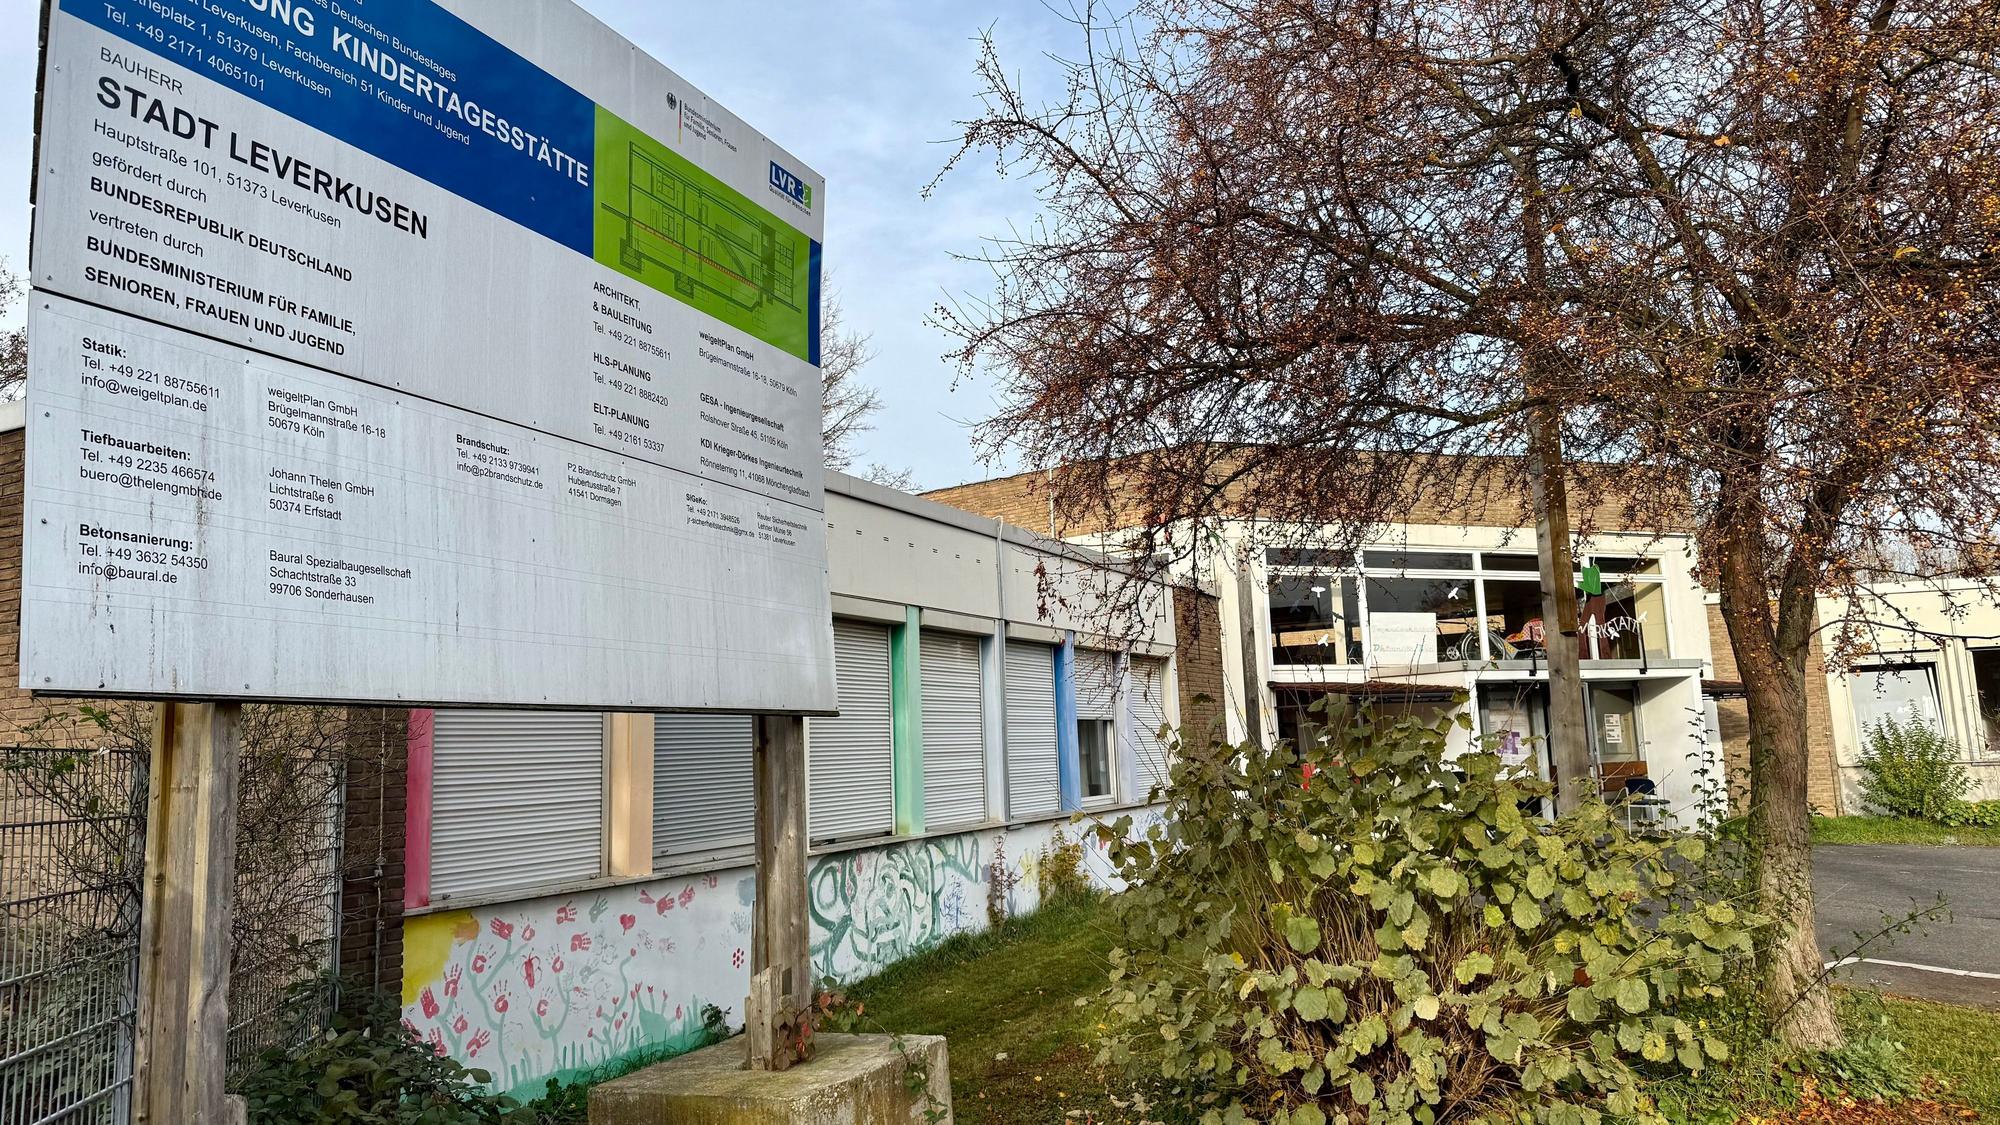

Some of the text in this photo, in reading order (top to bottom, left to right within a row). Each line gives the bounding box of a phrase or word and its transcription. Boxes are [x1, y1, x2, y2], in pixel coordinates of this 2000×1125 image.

[104, 3, 264, 92] Tel. +49 2171 4065101
[132, 0, 332, 98] theplatz 1, 51379 Leverkusen
[310, 0, 456, 82] es Deutschen Bundestages
[100, 46, 182, 95] BAUHERR
[203, 0, 470, 145] Leverkusen, Fachbereich 51 Kinder und Jugend
[332, 26, 588, 187] KINDERTAGESSTÄTTE
[94, 118, 341, 228] Hauptstraße 101, 51373 Leverkusen
[97, 76, 428, 240] STADT LEVERKUSEN
[92, 150, 207, 203] gefördert durch
[772, 165, 796, 196] LVR
[90, 176, 352, 282] BUNDESREPUBLIK DEUTSCHLAND
[90, 209, 204, 258] vertreten durch
[87, 236, 356, 336] BUNDESMINISTERIUM FÜR FAMILIE,
[594, 281, 640, 311] ARCHITEKT,
[84, 266, 344, 356] SENIOREN, FRAUEN UND JUGEND
[592, 301, 652, 334] & BAULEITUNG
[82, 336, 126, 358] Statik:
[593, 320, 606, 335] Tel.
[608, 330, 622, 342] +49
[624, 334, 636, 347] 221
[699, 330, 754, 362] weigeltPlan GmbH
[82, 354, 220, 399] Tel. +49 221 88755611
[594, 352, 651, 382] HLS-PLANUNG
[81, 373, 207, 412] info@weigeltplan.de
[593, 372, 606, 384] Tel.
[608, 379, 622, 390] +49
[624, 382, 636, 396] 221
[786, 386, 798, 398] Köln
[268, 386, 358, 416] weigeltPlan GmbH
[700, 392, 719, 408] GESA
[268, 401, 386, 438] Brügelmannstraße 16-18
[268, 416, 325, 438] 50679 Köln
[594, 402, 650, 429] ELT-PLANUNG
[80, 428, 191, 461] Tiefbauarbeiten:
[456, 434, 510, 456] Brandschutz:
[593, 422, 664, 452] Tel. +49 2161 53337
[730, 422, 750, 436] Straße
[776, 439, 788, 450] Köln
[80, 448, 216, 482] Tel. +49 2235 466574
[456, 448, 540, 476] Tel. +49 2133 9739941
[456, 462, 544, 490] info@p2brandschutz.de
[568, 462, 636, 488] P2 Brandschutz GmbH
[269, 467, 375, 496] Johann Thelen GmbH
[269, 482, 334, 504] Lichtstraße 6
[568, 475, 621, 495] Hubertusstraße 7
[269, 498, 342, 520] 50374 Erfstadt
[568, 488, 622, 508] 41541 Dormagen
[80, 524, 193, 552] Betonsanierung:
[79, 542, 208, 570] Tel. +49 3632 54350
[270, 550, 412, 579] Baural Spezialbaugesellschaft
[78, 562, 178, 584] info@baural.de
[270, 566, 356, 586] Schachtstraße 33
[270, 582, 374, 604] 99706 Sonderhausen
